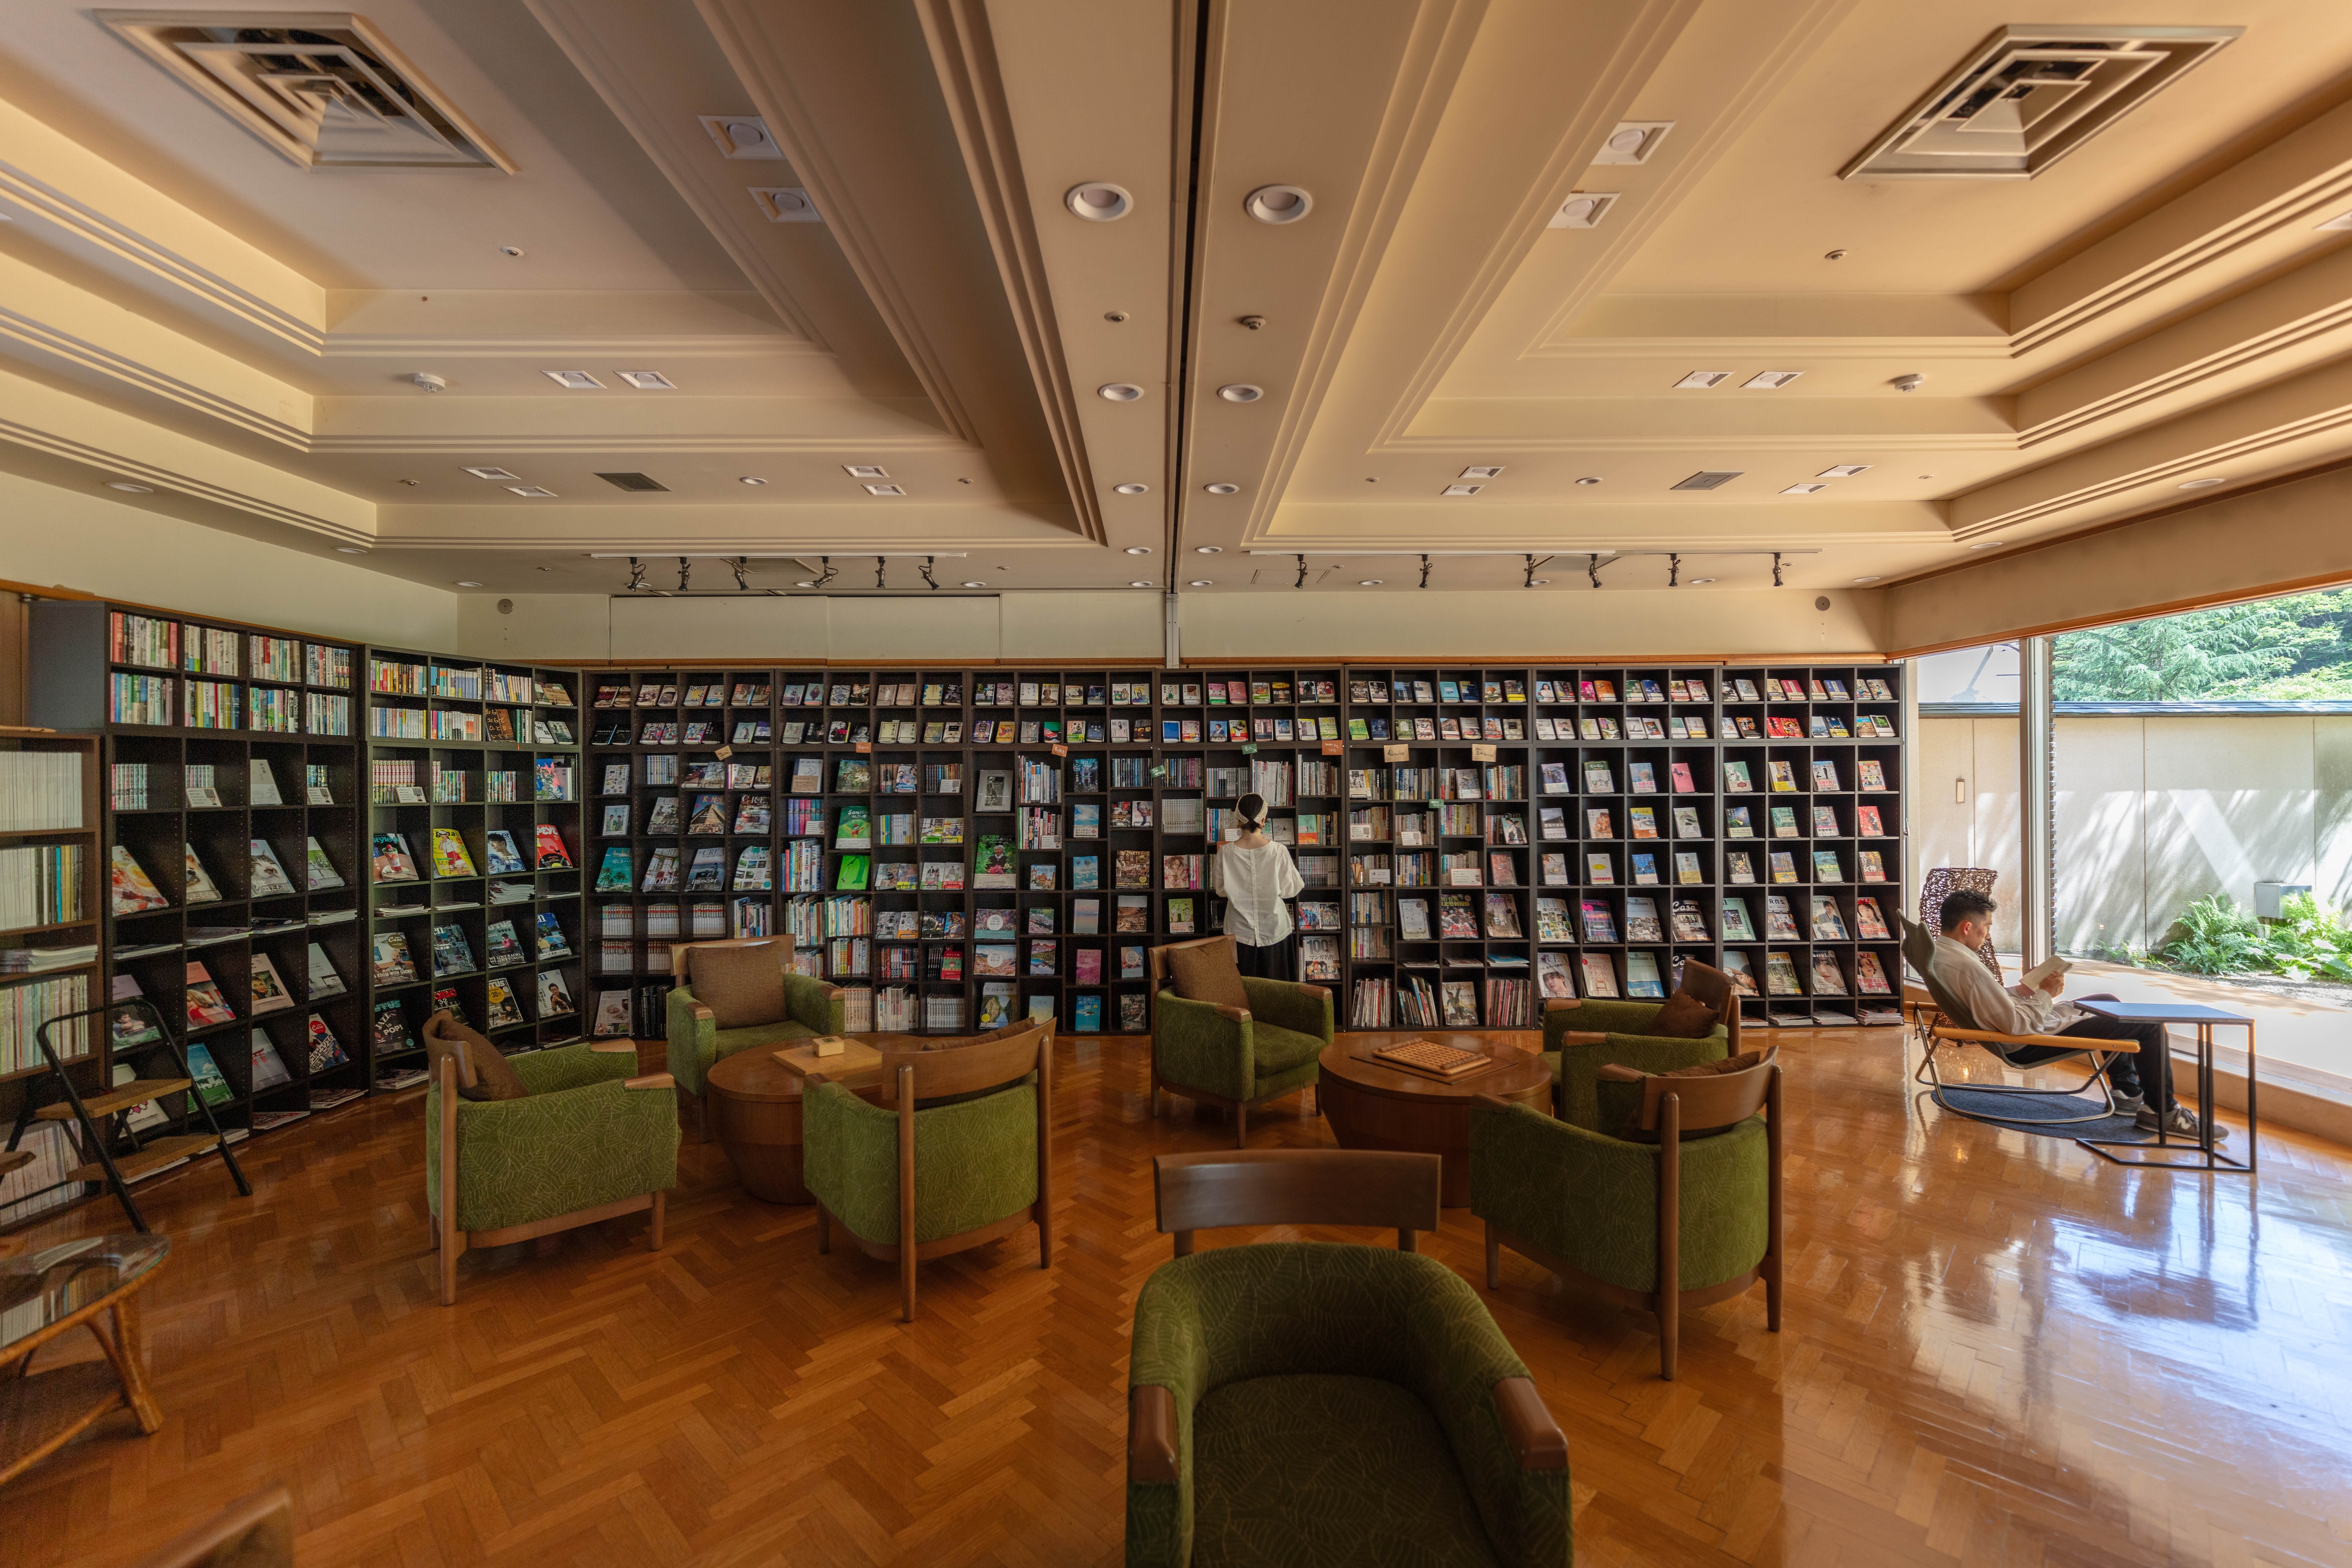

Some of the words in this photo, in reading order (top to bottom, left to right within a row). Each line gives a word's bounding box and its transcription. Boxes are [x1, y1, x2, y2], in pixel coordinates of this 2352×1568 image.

[1673, 901, 1696, 912] Casa
[1307, 939, 1329, 955] 100
[375, 1013, 391, 1030] JAZZ
[383, 1024, 403, 1035] POP!
